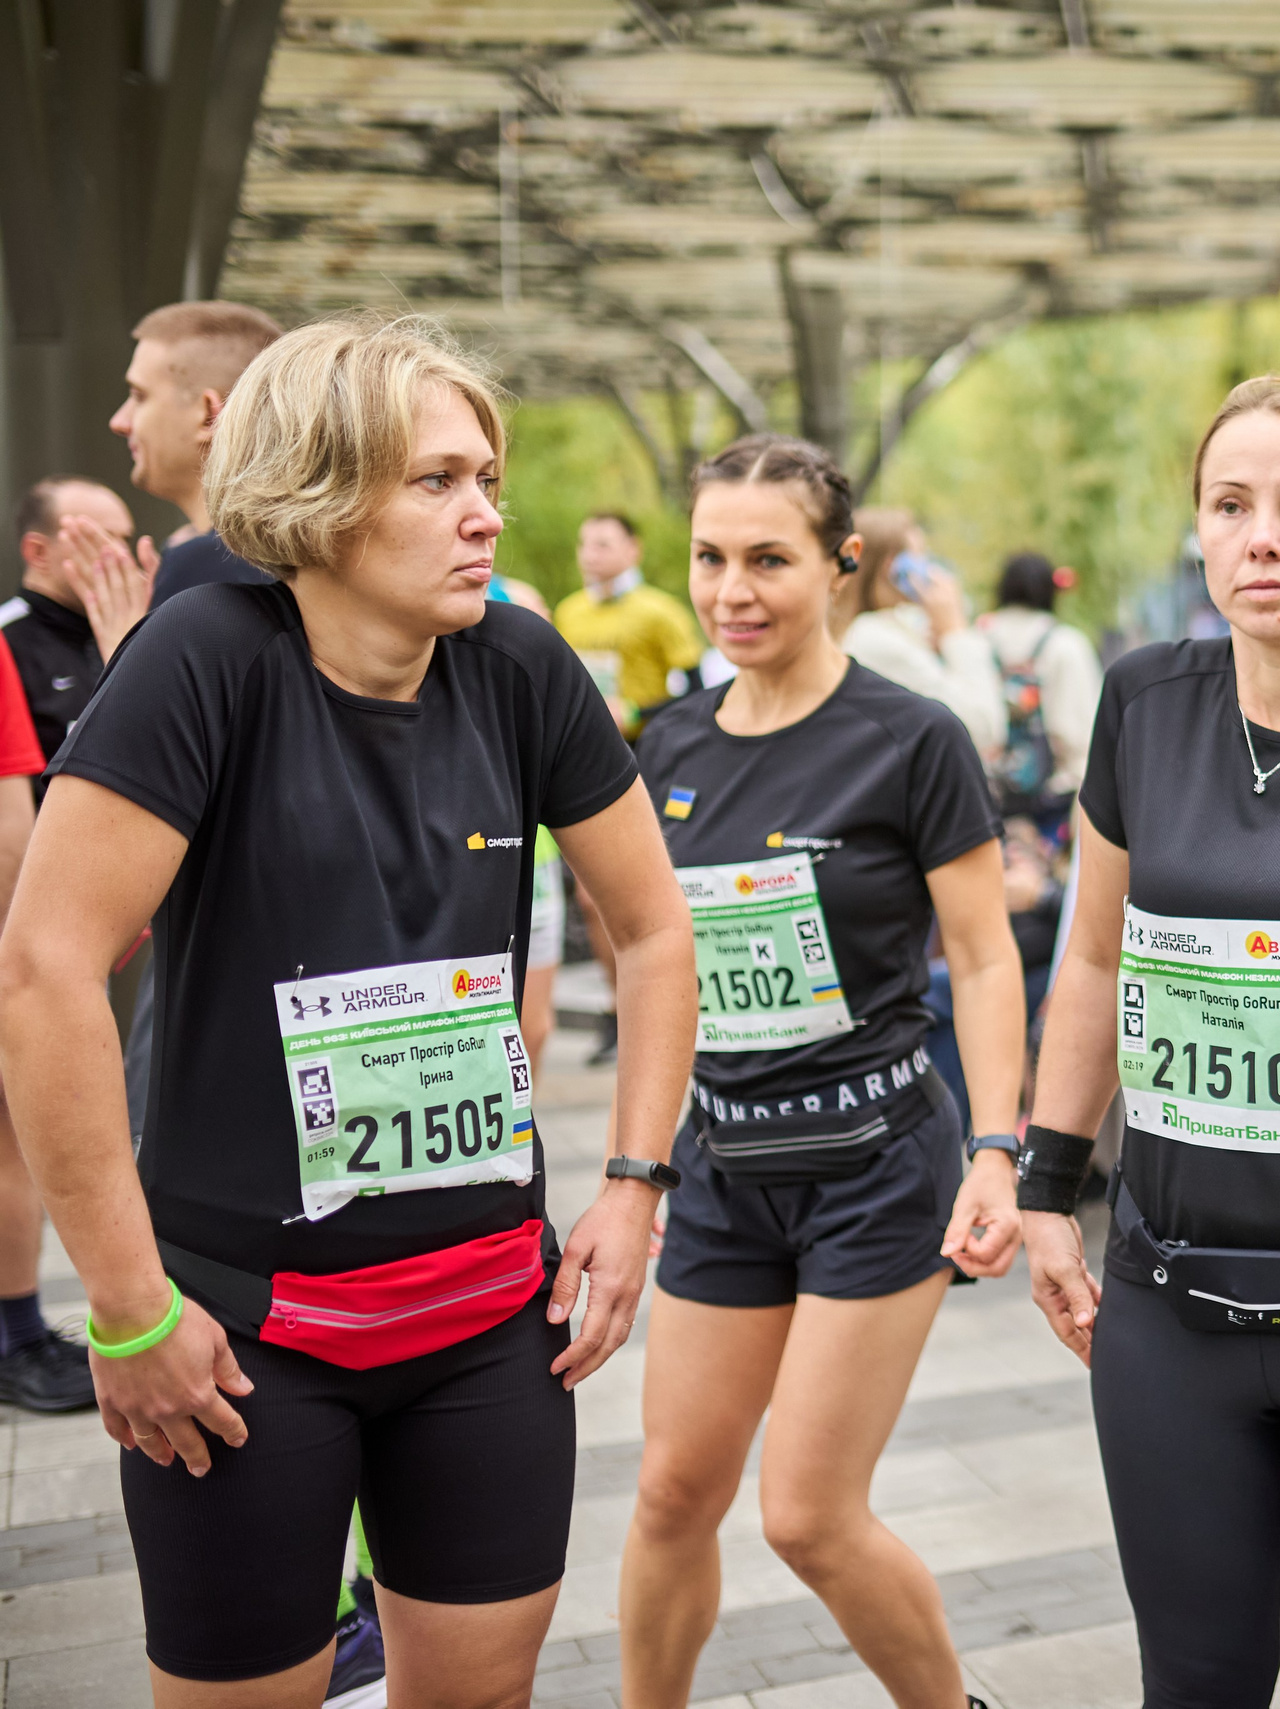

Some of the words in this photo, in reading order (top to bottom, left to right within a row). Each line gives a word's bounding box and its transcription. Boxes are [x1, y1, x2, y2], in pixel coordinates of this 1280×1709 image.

[1149, 929, 1197, 944] UNDER
[1150, 940, 1212, 956] ARMOUR
[1200, 970, 1243, 982] МАРАФОН
[341, 983, 408, 1002] UNDER
[1166, 984, 1197, 1001] Смарт
[1200, 990, 1239, 1010] Простір
[343, 992, 425, 1014] ARMOUR
[1202, 1012, 1245, 1031] Наталія
[290, 1038, 321, 1051] ДЕНЬ
[350, 1021, 411, 1039] КИЇВСЬКИЙ
[412, 1017, 455, 1030] МАРАФОН
[361, 1053, 405, 1069] Смарт
[410, 1041, 454, 1063] Простір
[457, 1036, 486, 1053] GoRun
[1123, 1059, 1143, 1071] 02:19
[420, 1070, 454, 1089] Ірина
[838, 1046, 931, 1111] ARMO
[343, 1092, 503, 1173] 21505
[307, 1147, 335, 1163] 01:59
